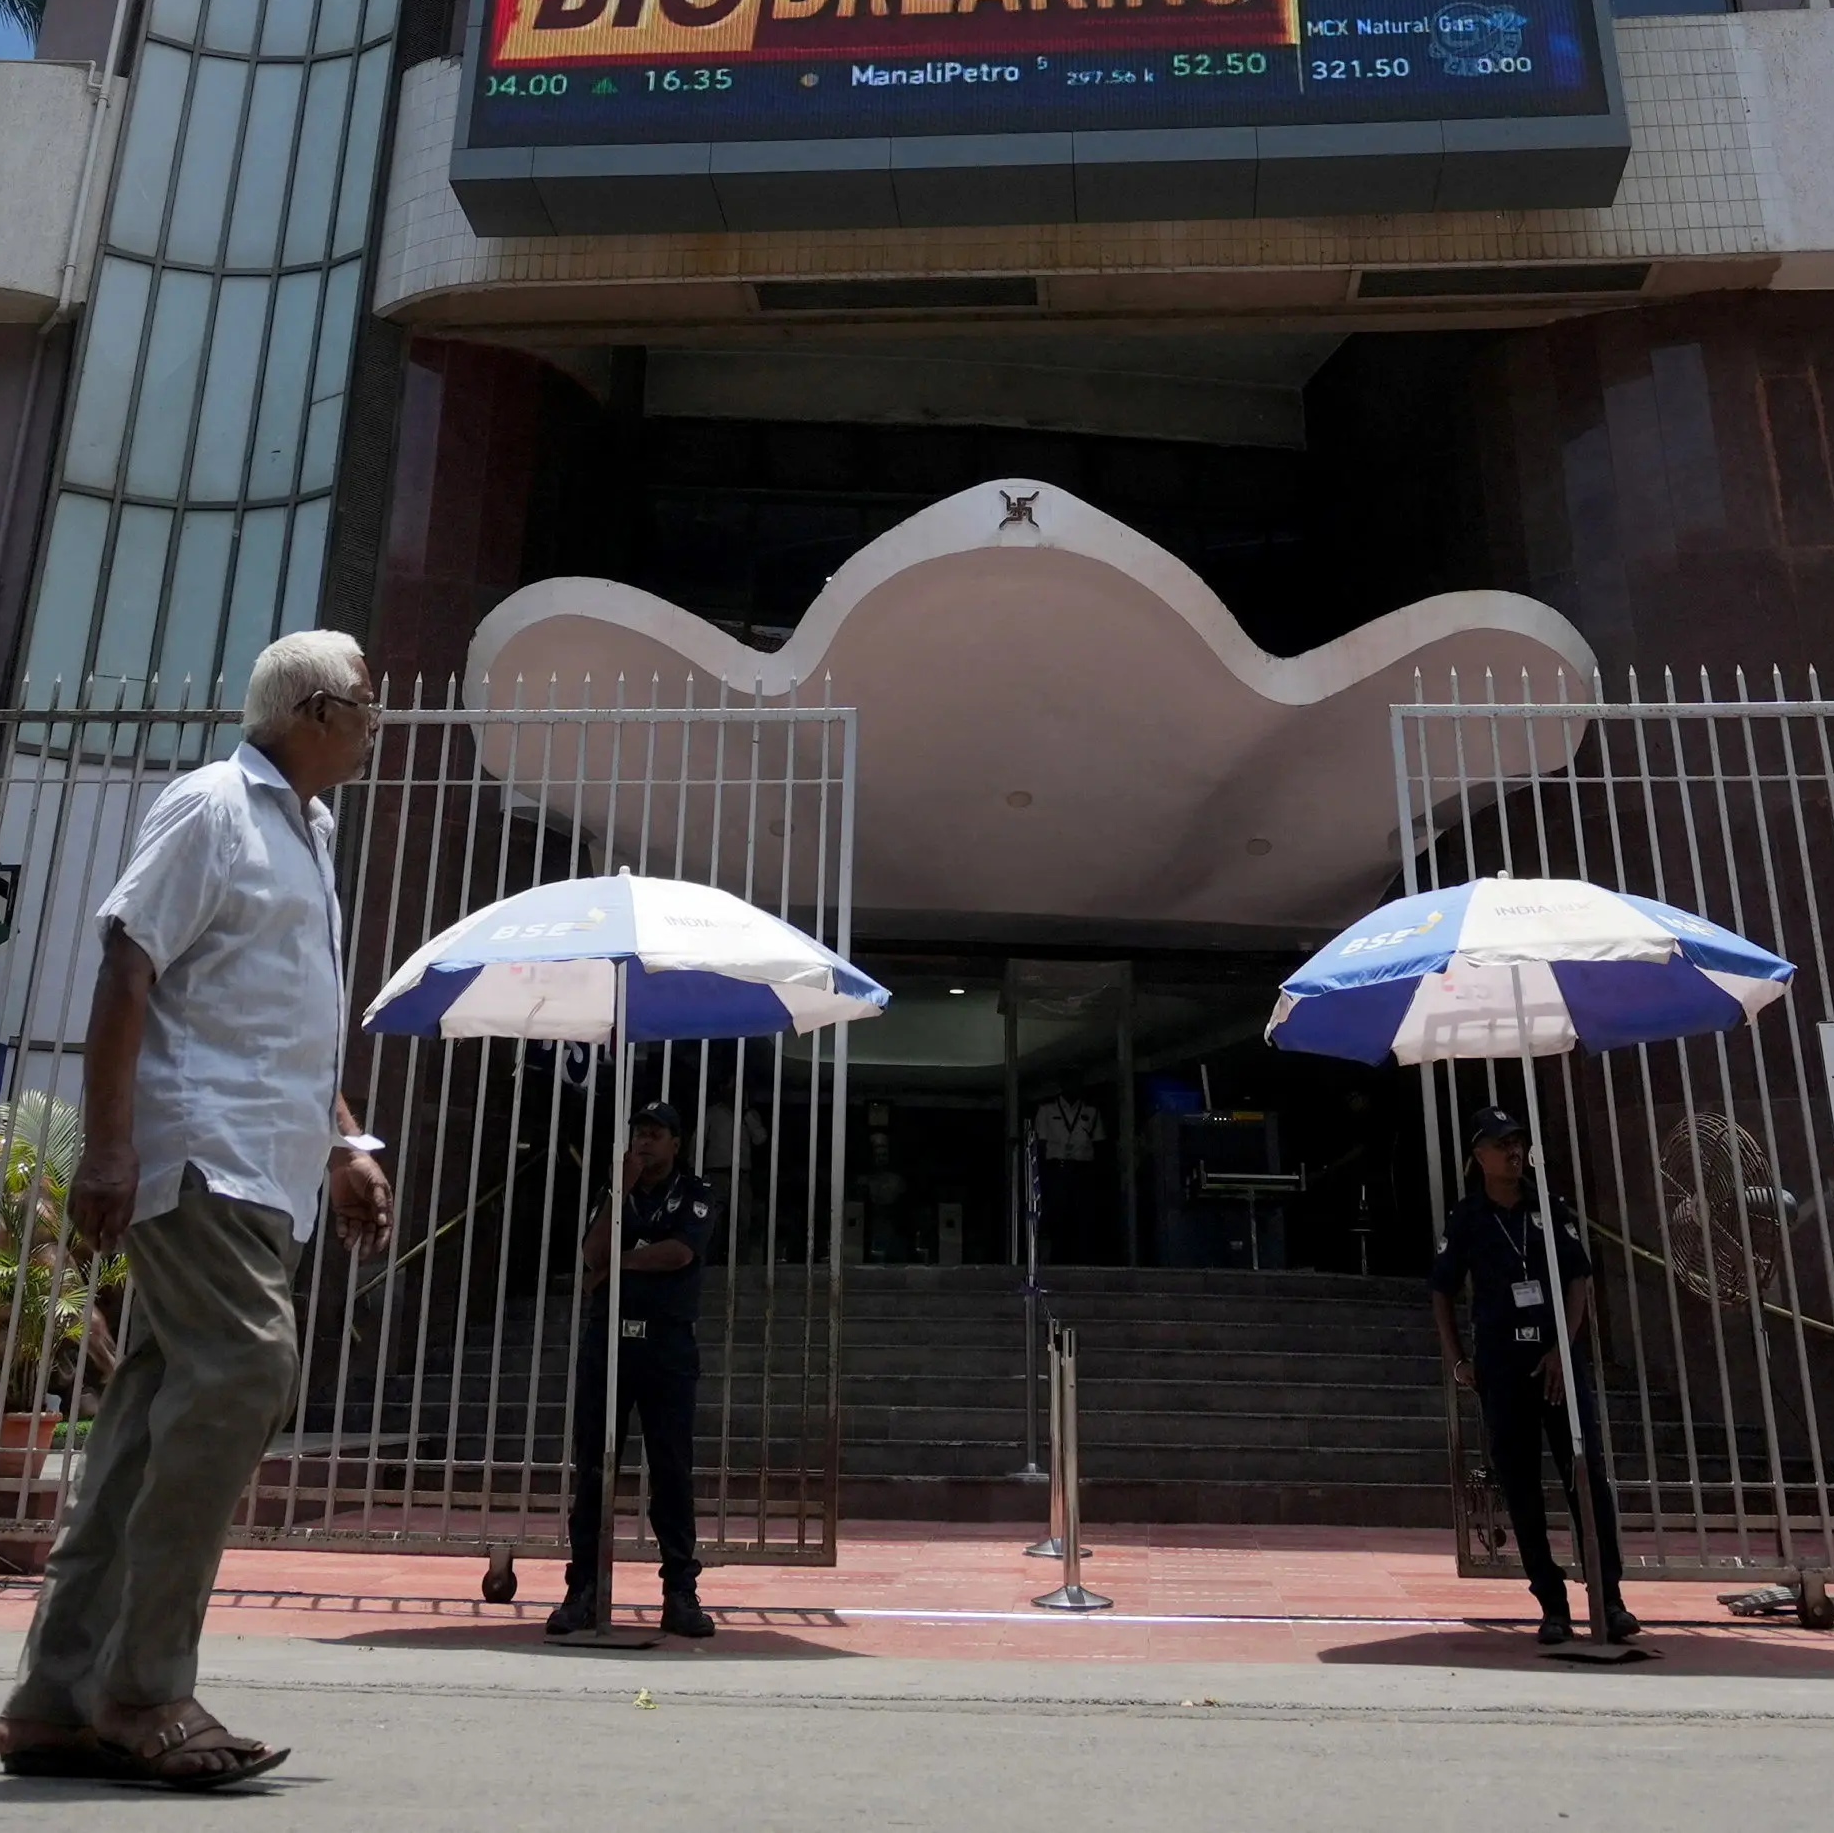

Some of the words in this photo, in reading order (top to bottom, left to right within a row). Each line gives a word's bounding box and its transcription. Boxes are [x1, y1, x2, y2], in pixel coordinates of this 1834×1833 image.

[1306, 18, 1349, 37] MCX
[1356, 16, 1430, 36] Natural
[1438, 15, 1476, 34] Gas
[645, 68, 733, 92] 16.35
[851, 58, 1020, 87] ManaliPetro
[1172, 52, 1267, 77] 52.50
[1311, 57, 1410, 80] 321.50
[1478, 56, 1532, 74] 0.00
[489, 921, 575, 940] BSE
[1338, 927, 1416, 956] BSE
